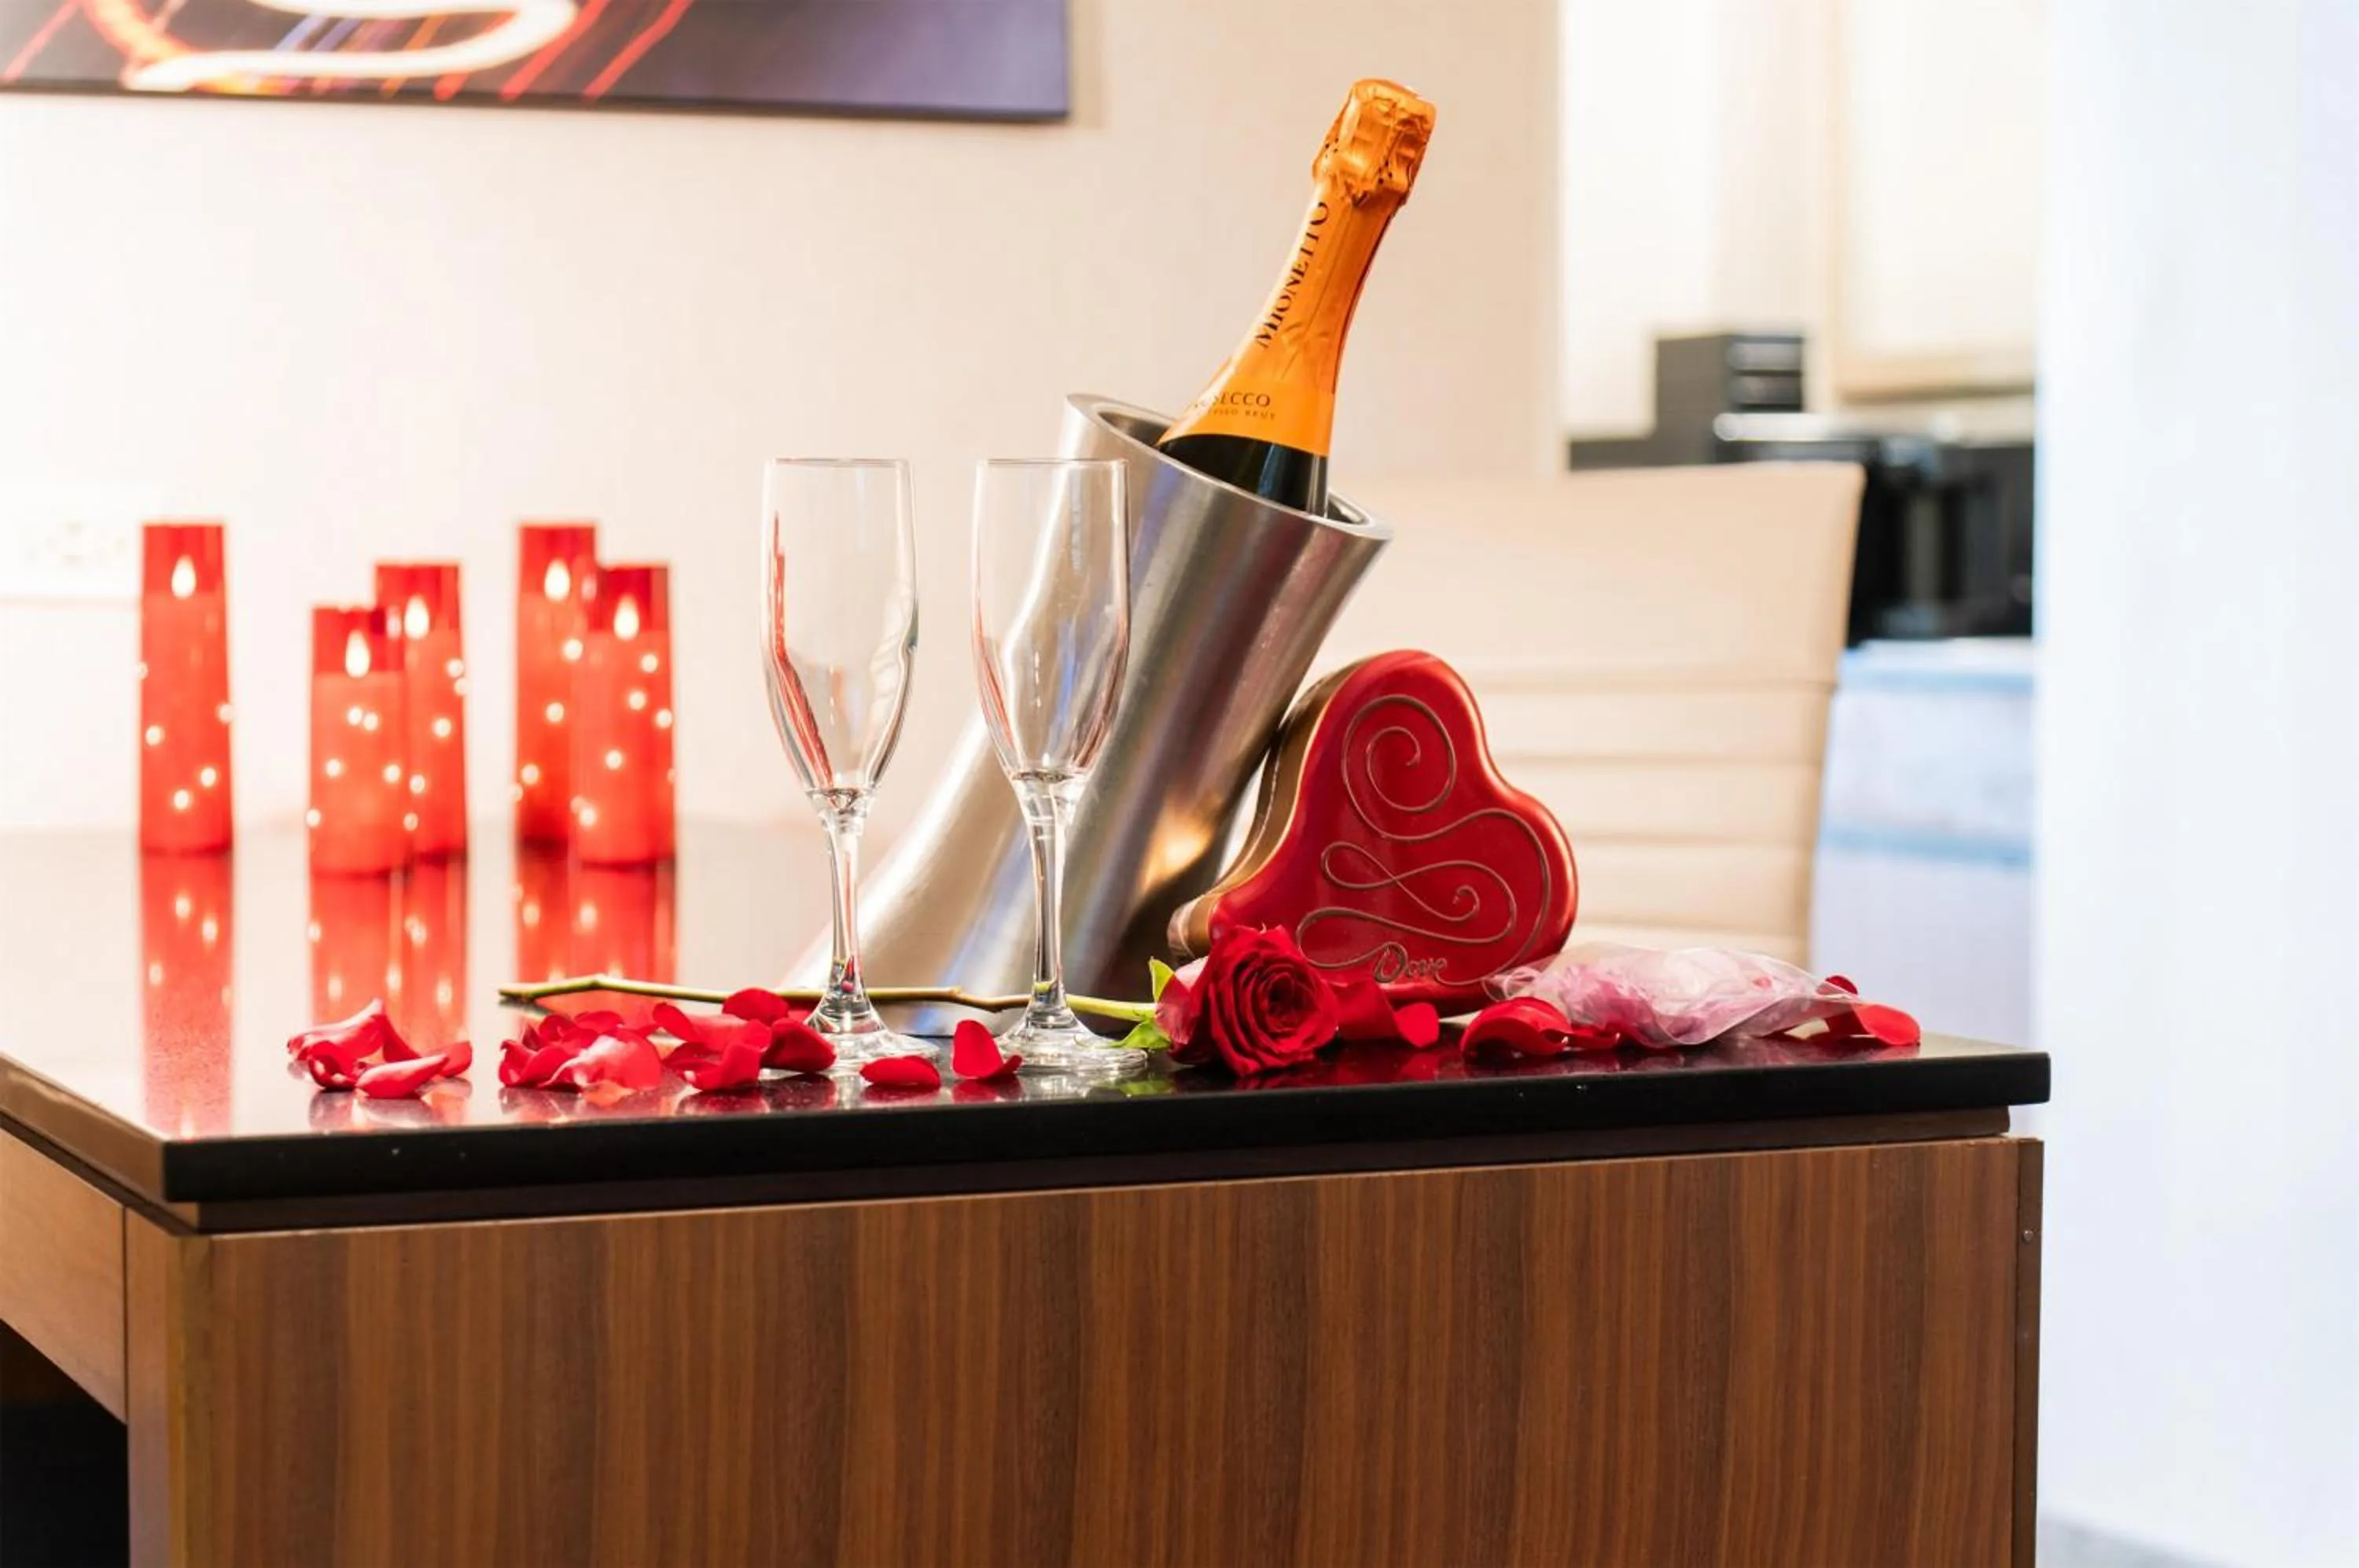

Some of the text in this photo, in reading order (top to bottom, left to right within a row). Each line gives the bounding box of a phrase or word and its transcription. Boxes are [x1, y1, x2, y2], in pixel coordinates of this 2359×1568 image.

[1254, 201, 1330, 348] MIONETTO
[1197, 392, 1271, 407] SECCO
[1374, 941, 1448, 983] Dove
